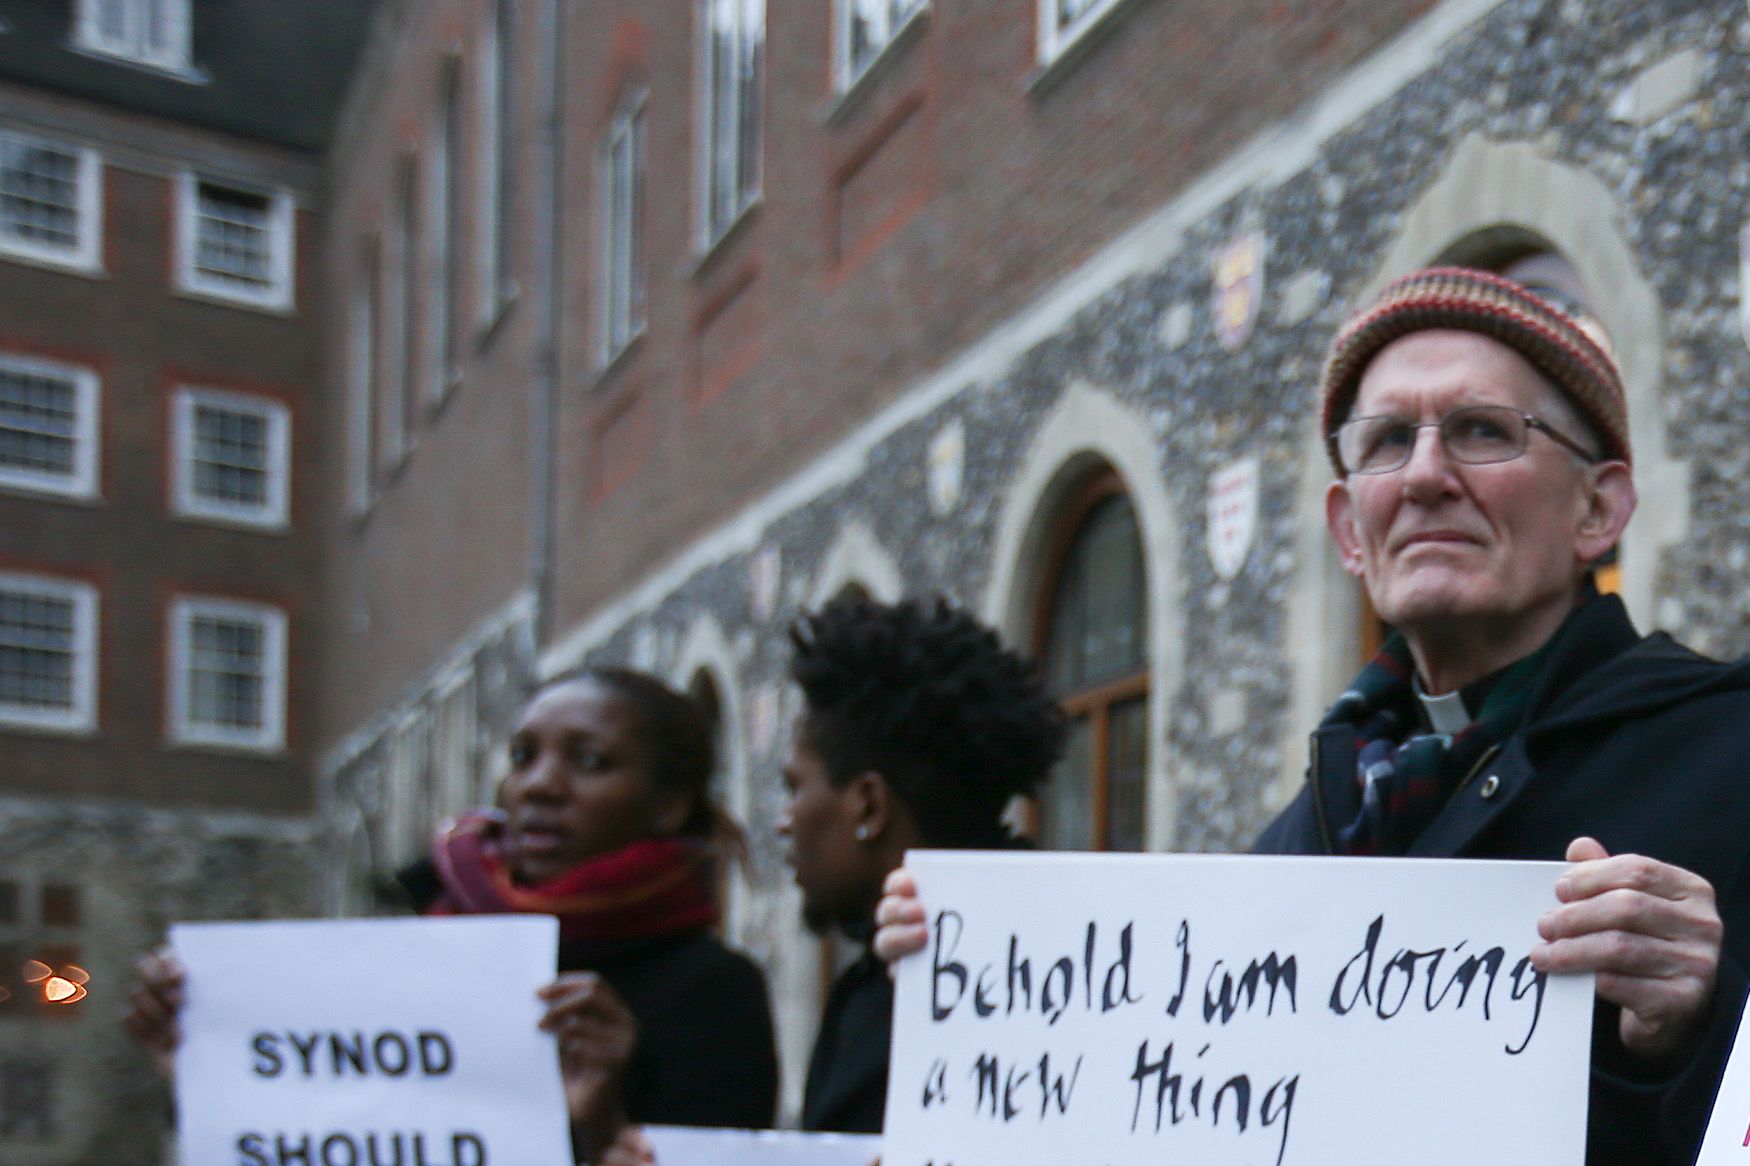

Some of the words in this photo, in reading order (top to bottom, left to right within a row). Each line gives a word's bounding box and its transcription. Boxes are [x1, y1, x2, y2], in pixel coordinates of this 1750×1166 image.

[929, 909, 1143, 1027] Behold
[1199, 949, 1300, 1026] am
[1330, 915, 1549, 1055] doing
[250, 1030, 454, 1078] SYNOD
[922, 1062, 949, 1109] a
[970, 1053, 1084, 1119] new
